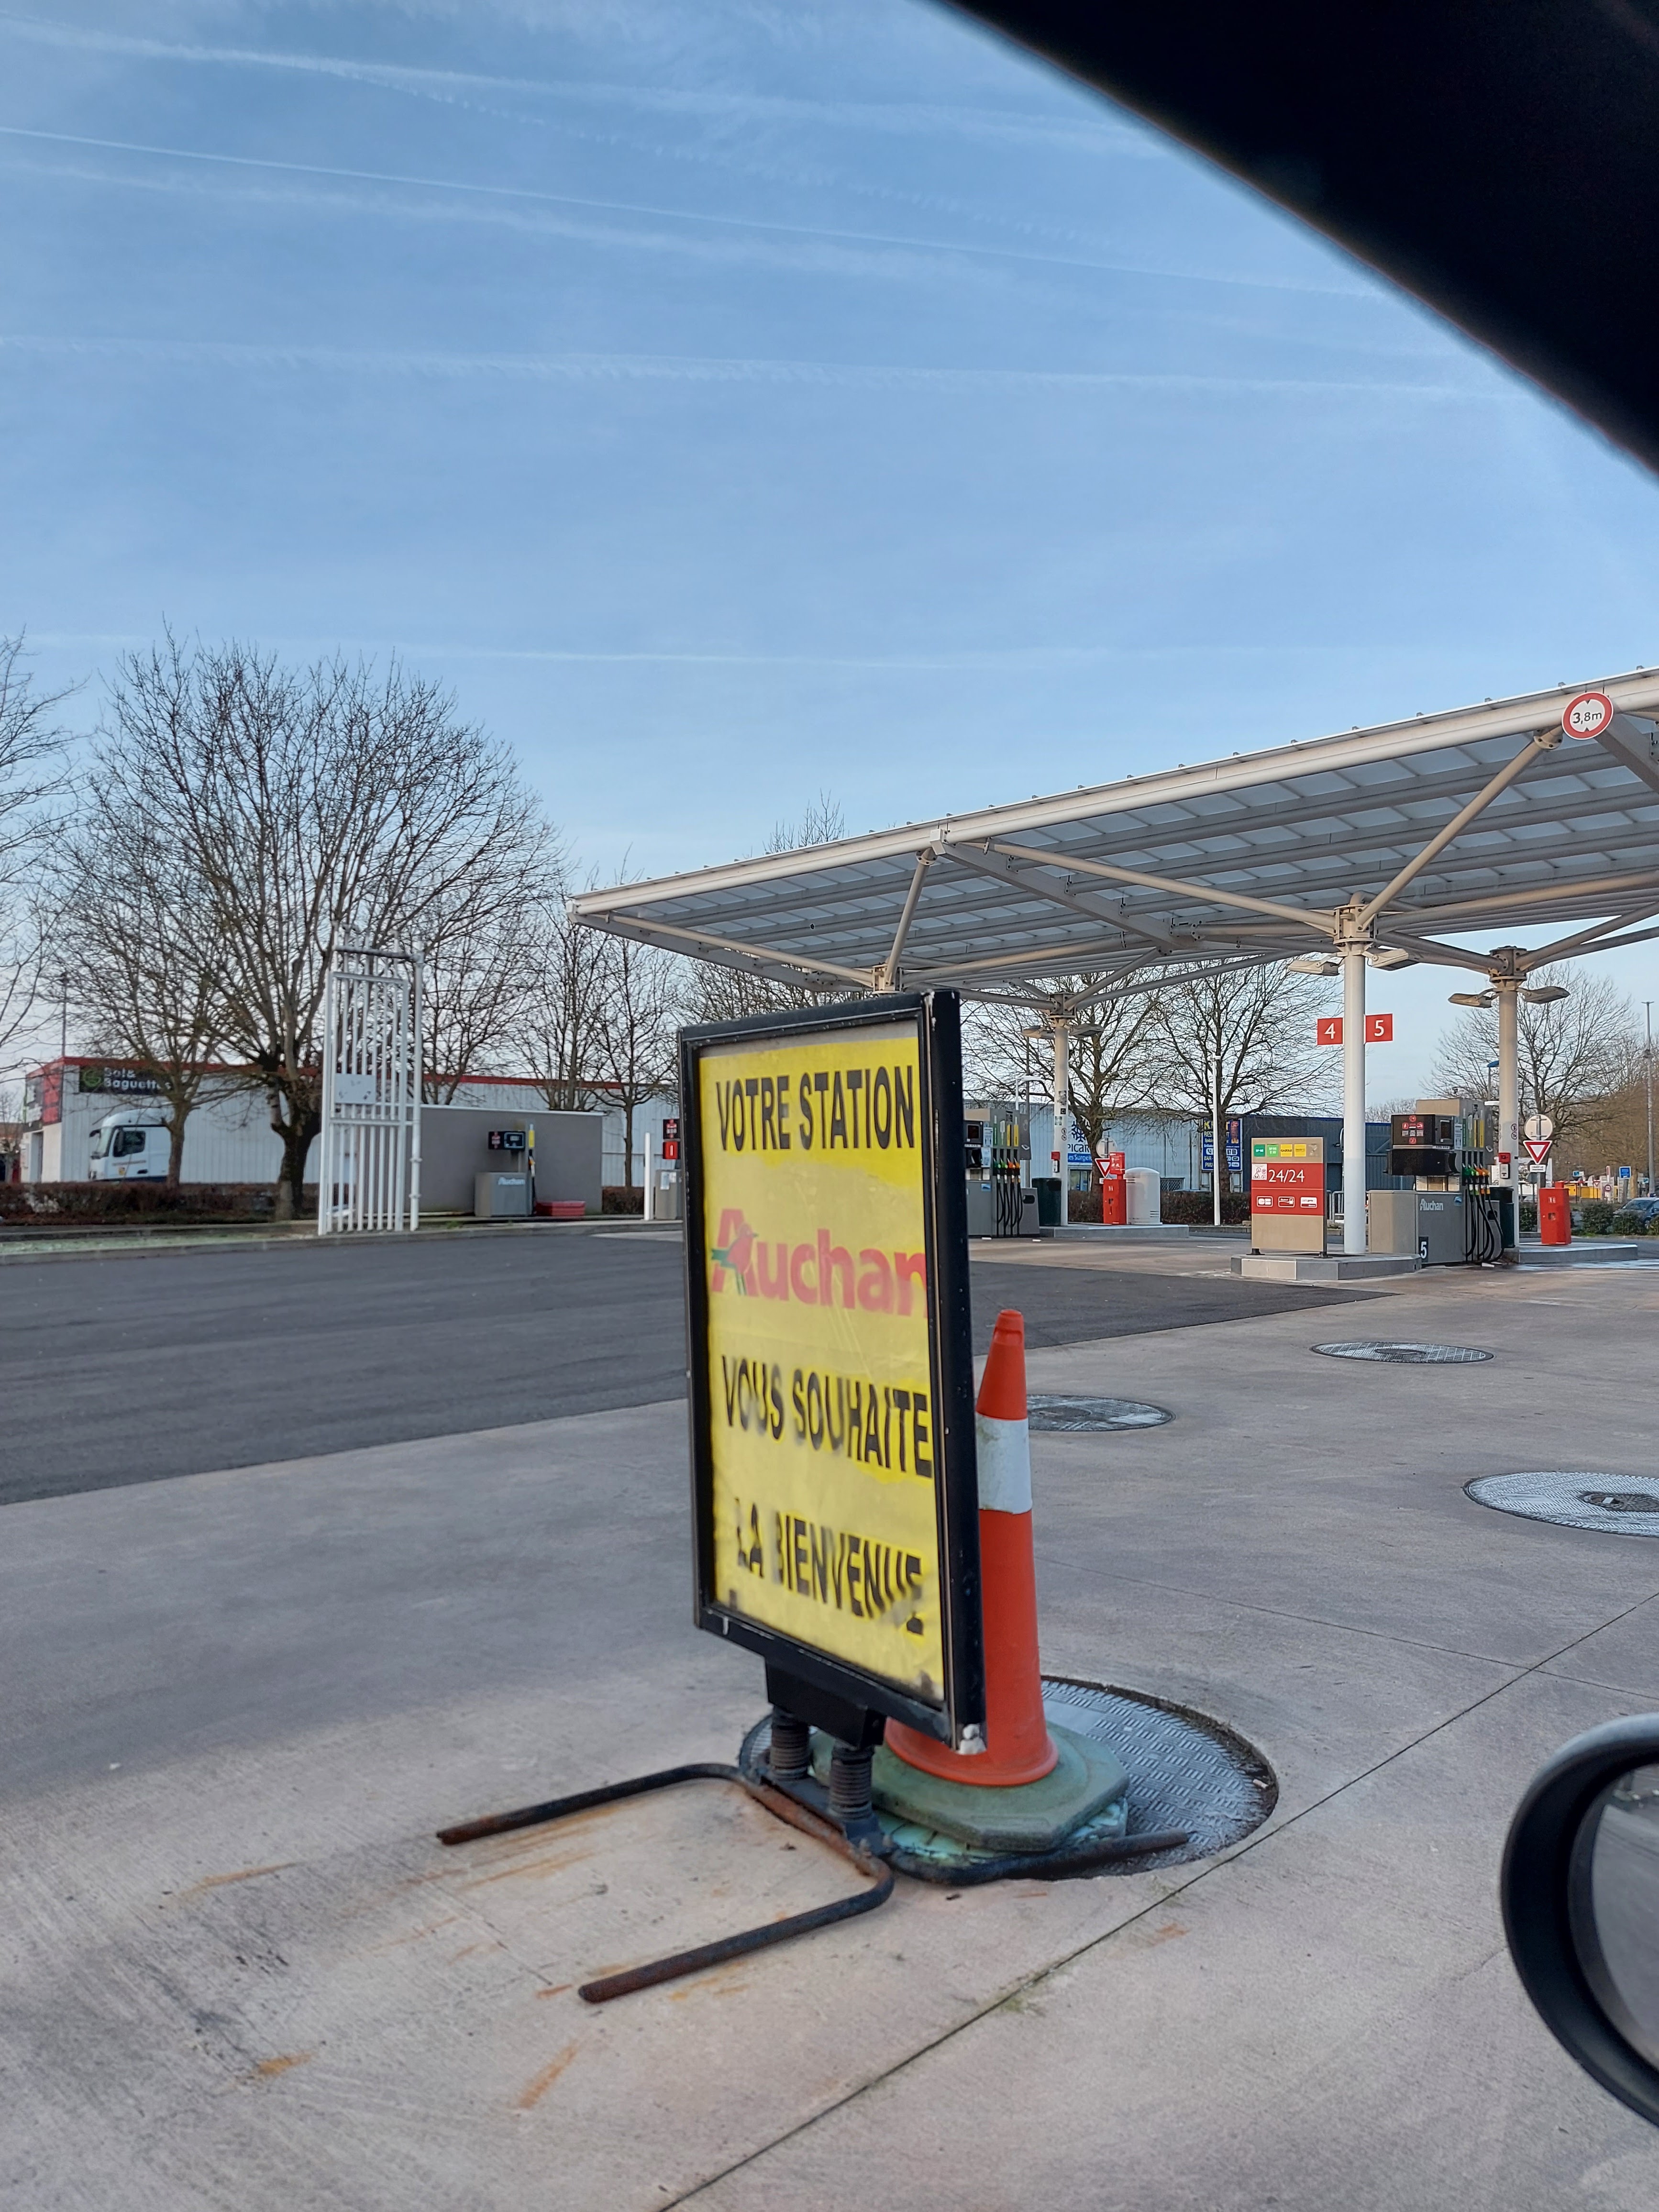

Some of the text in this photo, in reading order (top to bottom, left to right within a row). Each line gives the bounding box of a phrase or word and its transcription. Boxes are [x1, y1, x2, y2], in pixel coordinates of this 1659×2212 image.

[1572, 712, 1602, 724] 3,8m
[1324, 1023, 1336, 1039] 4
[1374, 1019, 1384, 1037] 5
[716, 1065, 915, 1151] VOTRE STATION
[1268, 1169, 1305, 1183] 24/24
[1420, 1198, 1443, 1211] Auchan
[1420, 1241, 1427, 1259] 5
[711, 1208, 928, 1319] Auchan
[722, 1355, 933, 1479] VOUS SOUHAITE
[734, 1497, 764, 1578] LA
